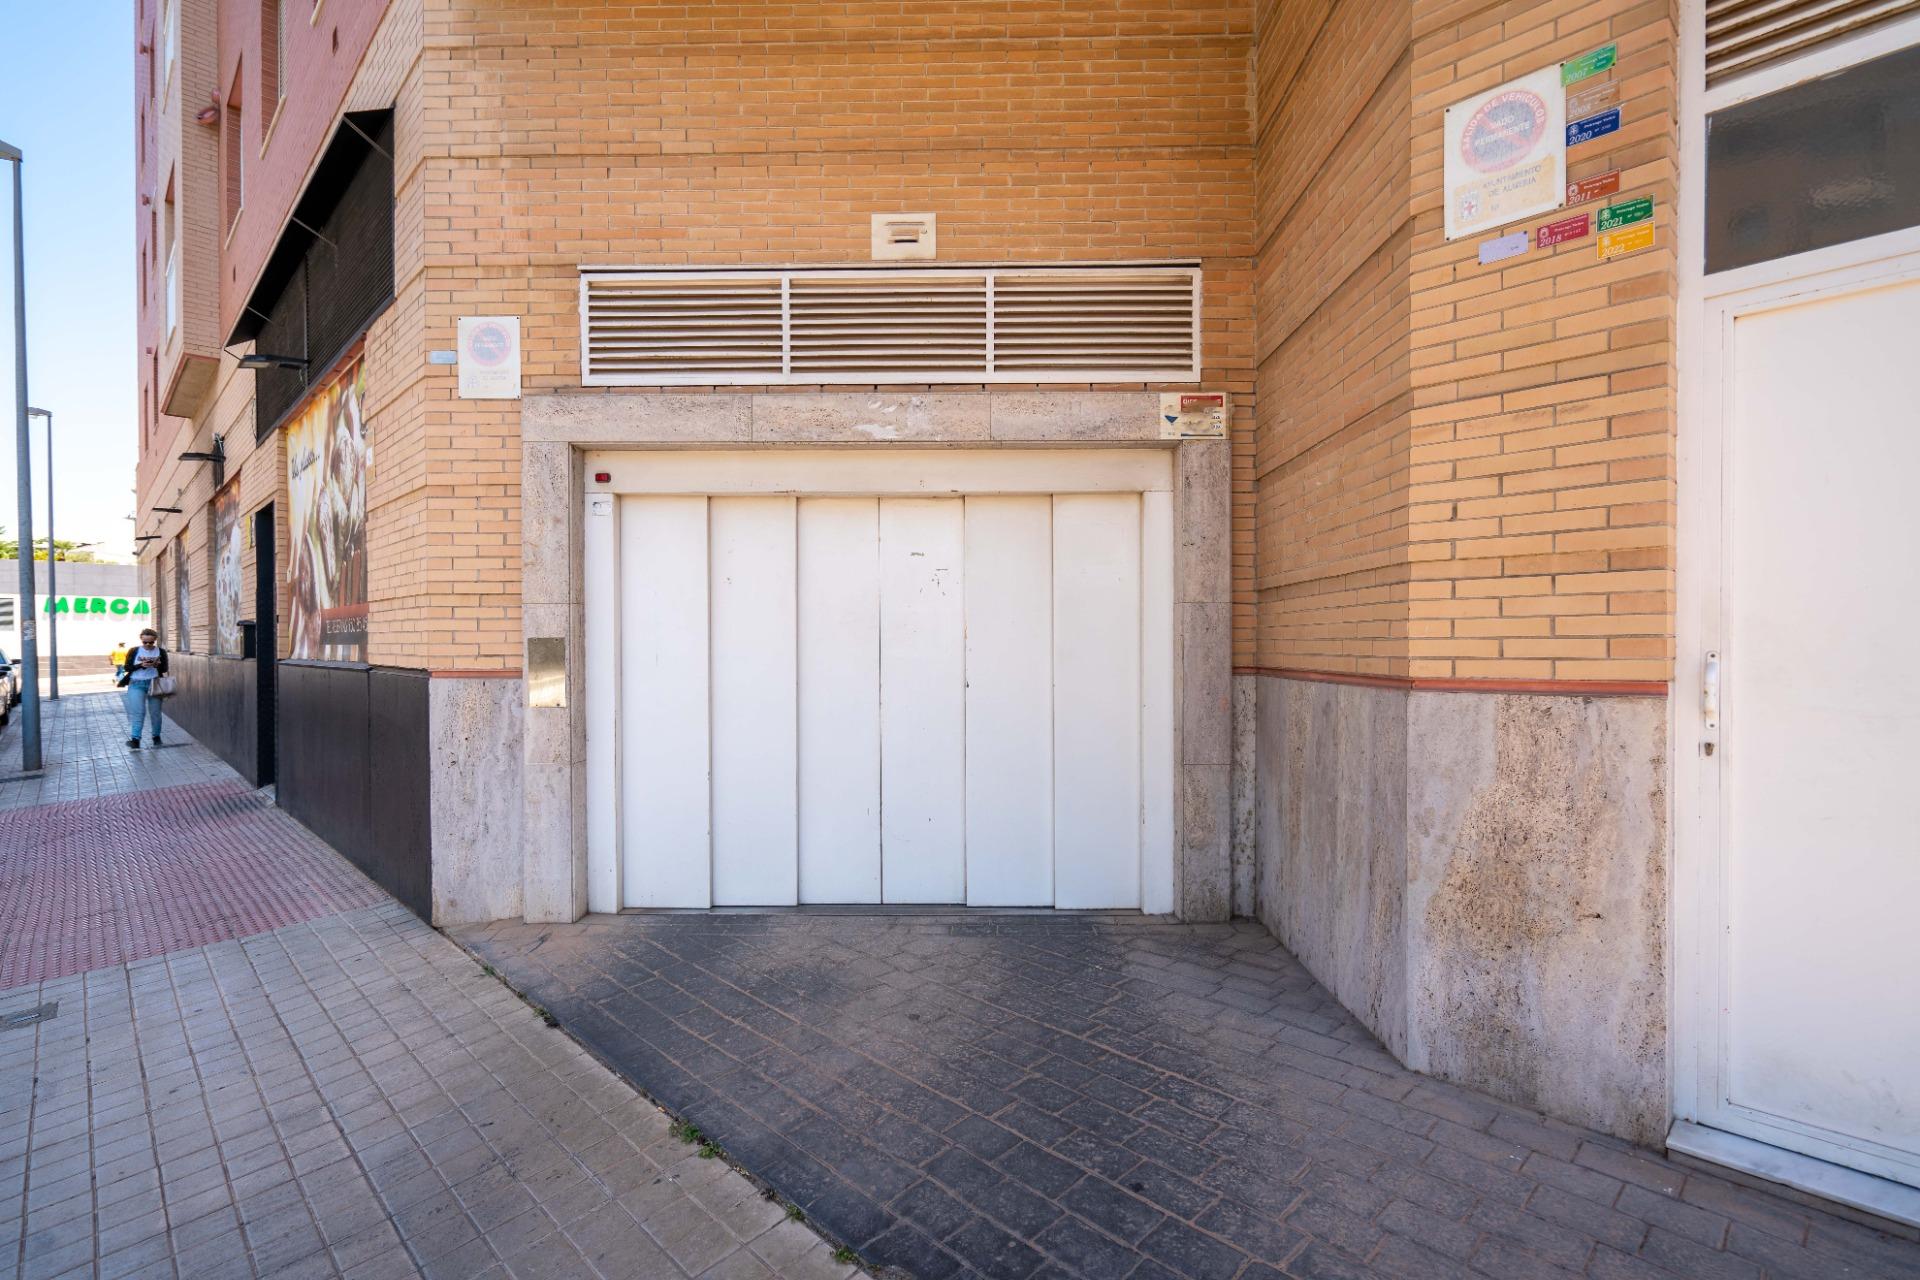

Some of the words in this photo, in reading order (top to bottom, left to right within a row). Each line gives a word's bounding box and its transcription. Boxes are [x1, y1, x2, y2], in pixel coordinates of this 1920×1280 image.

[1502, 92, 1545, 125] VEHICULOS
[1569, 130, 1592, 145] 2020
[1568, 191, 1591, 205] 2011
[1600, 216, 1623, 230] 2021
[1540, 233, 1562, 247] 2018
[1602, 243, 1625, 258] 2022
[44, 597, 150, 614] MERCA
